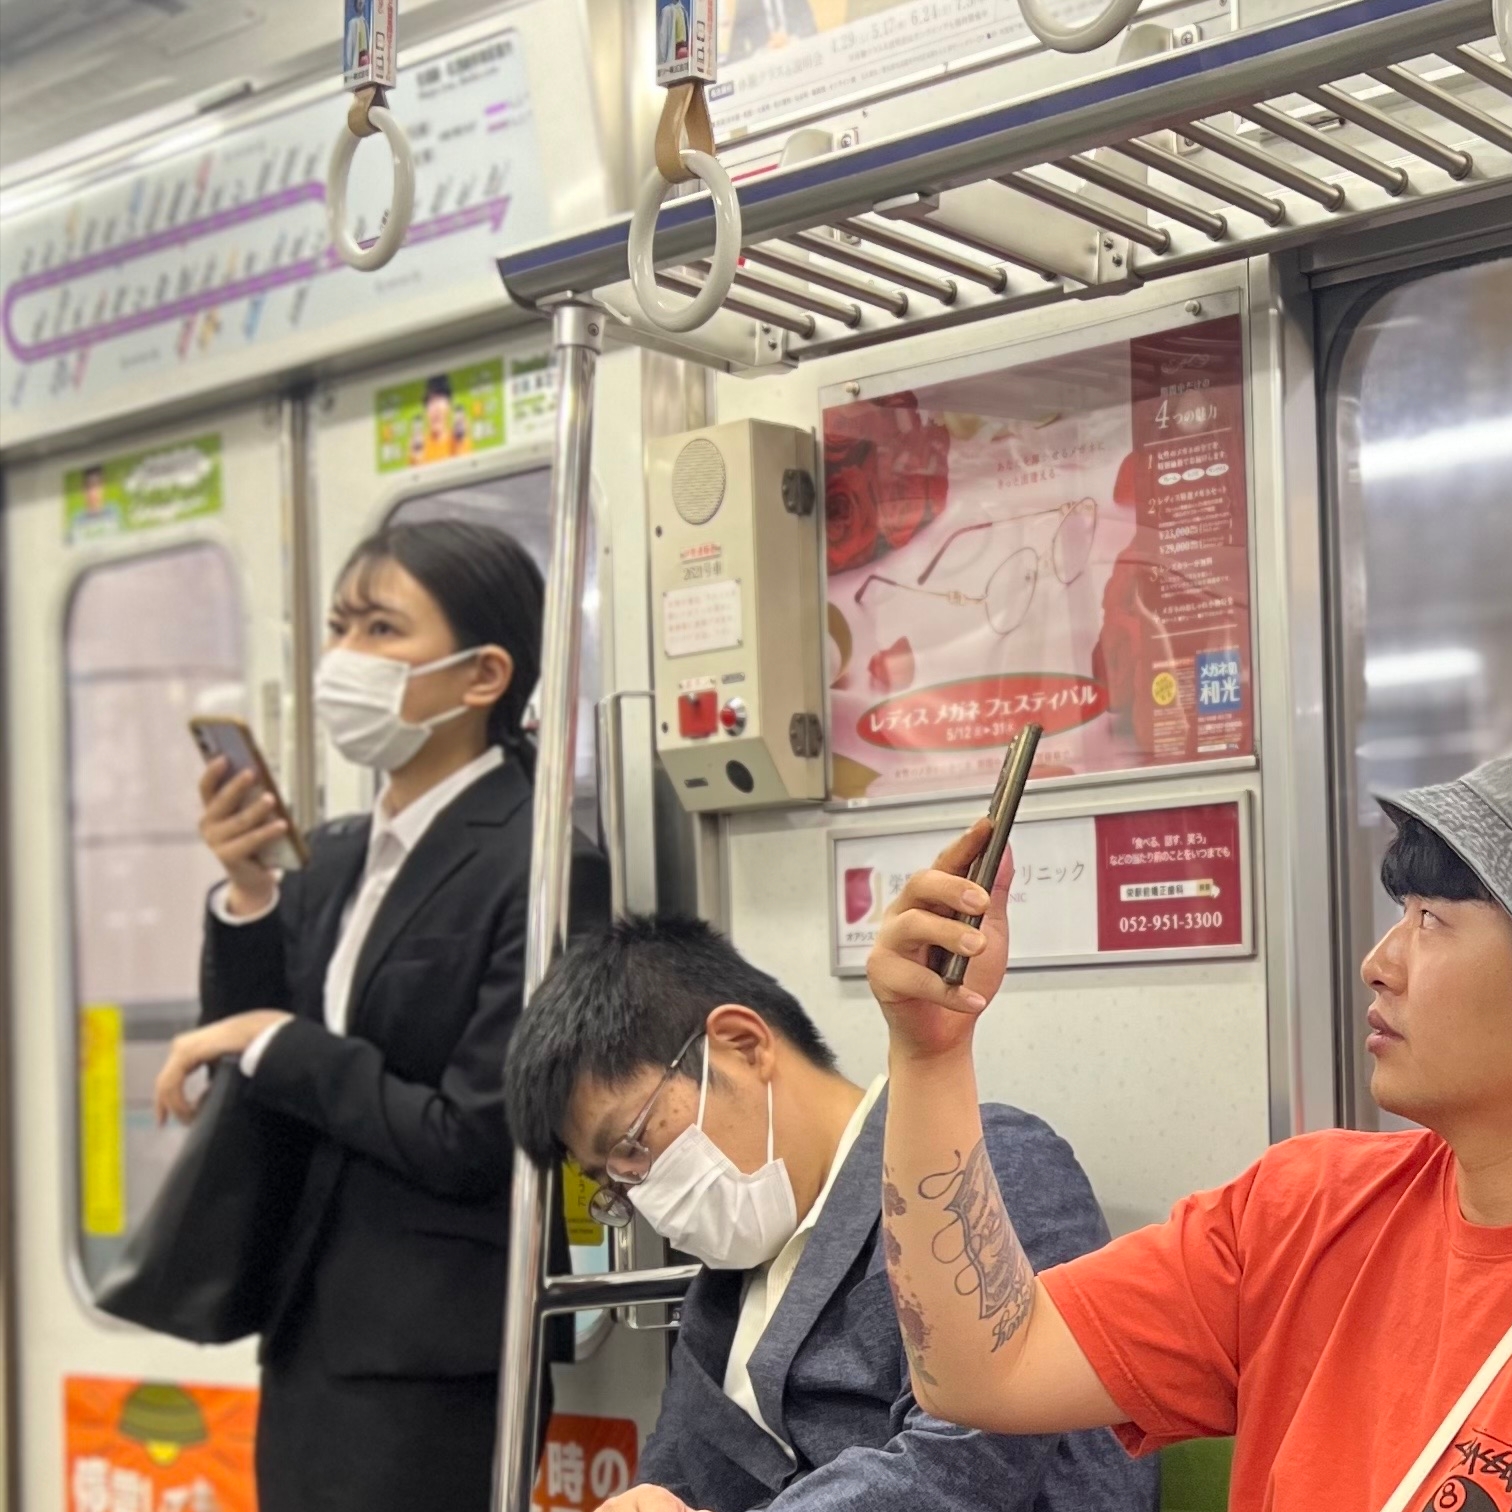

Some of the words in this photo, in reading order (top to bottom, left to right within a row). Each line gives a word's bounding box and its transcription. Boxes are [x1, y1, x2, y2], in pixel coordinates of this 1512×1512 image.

[1199, 676, 1241, 705] 和光
[869, 708, 929, 733] レディス
[935, 699, 981, 725] メガネ
[986, 685, 1098, 716] フェスティバル
[1119, 911, 1223, 933] 052-951-3300
[1439, 1482, 1458, 1509] 8
